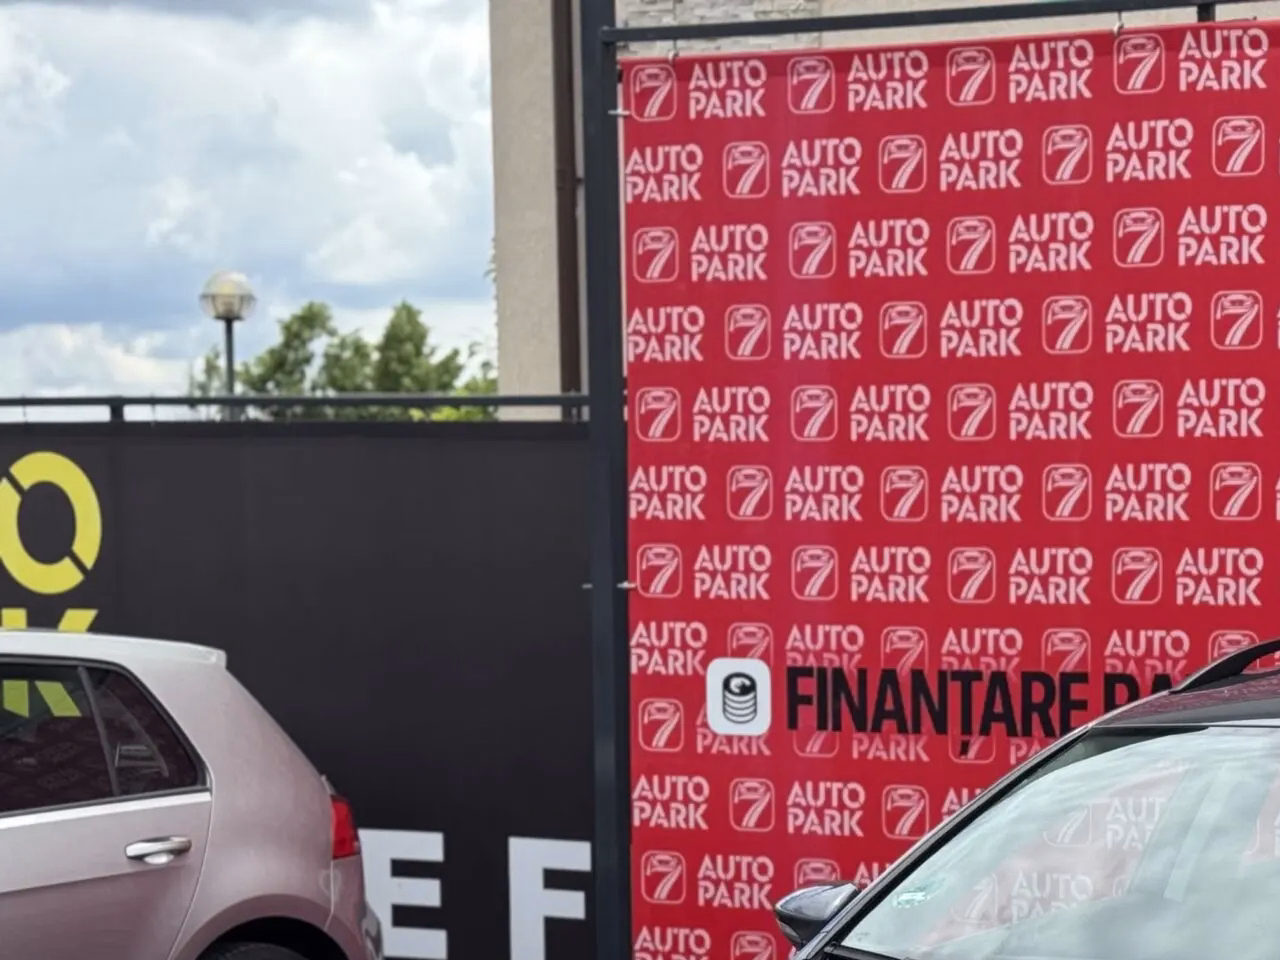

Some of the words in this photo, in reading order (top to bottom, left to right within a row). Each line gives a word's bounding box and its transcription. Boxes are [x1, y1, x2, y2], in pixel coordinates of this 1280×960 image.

[1009, 39, 1093, 72] AUTO
[1179, 28, 1268, 59] AUTO
[689, 60, 766, 89] AUTO
[848, 51, 928, 81] AUTO
[1180, 59, 1266, 91] PARK
[848, 79, 927, 111] PARK
[1009, 69, 1092, 103] PARK
[690, 88, 765, 119] PARK
[940, 129, 1023, 161] AUTO
[1106, 118, 1193, 151] AUTO
[625, 144, 702, 174] AUTO
[781, 137, 861, 168] AUTO
[1107, 149, 1191, 182] PARK
[626, 174, 702, 203] PARK
[782, 166, 860, 197] PARK
[940, 159, 1020, 191] PARK
[848, 218, 929, 248] AUTO
[1009, 211, 1094, 242] AUTO
[1178, 204, 1267, 235] AUTO
[691, 224, 768, 252] AUTO
[1179, 235, 1264, 266] PARK
[692, 253, 767, 281] PARK
[849, 248, 928, 277] PARK
[1010, 241, 1091, 273] PARK
[627, 306, 704, 336] AUTO
[783, 302, 862, 331] AUTO
[940, 298, 1023, 328] AUTO
[1106, 292, 1192, 322] AUTO
[628, 334, 704, 362] PARK
[784, 331, 860, 360] PARK
[941, 328, 1021, 357] PARK
[1106, 322, 1190, 352] PARK
[693, 386, 770, 413] AUTO
[850, 384, 930, 412] AUTO
[1009, 381, 1093, 410] AUTO
[1177, 378, 1265, 407] AUTO
[694, 414, 768, 441] PARK
[851, 413, 928, 441] PARK
[1010, 411, 1091, 440] PARK
[1178, 408, 1263, 437] PARK
[629, 465, 706, 492] AUTO
[785, 466, 864, 493] AUTO
[941, 465, 1023, 493] AUTO
[1105, 463, 1191, 491] AUTO
[630, 493, 704, 520] PARK
[786, 494, 861, 520] PARK
[942, 494, 1021, 522] PARK
[1106, 493, 1189, 520] PARK
[694, 545, 771, 572] AUTO
[851, 547, 930, 573] AUTO
[1009, 547, 1092, 575] AUTO
[1176, 548, 1263, 576] AUTO
[695, 572, 769, 599] PARK
[851, 574, 928, 602] PARK
[1010, 576, 1090, 604] PARK
[1177, 577, 1261, 605] PARK
[630, 622, 707, 648] AUTO
[786, 624, 864, 651] AUTO
[942, 628, 1022, 654] AUTO
[1105, 630, 1189, 657] AUTO
[630, 649, 705, 676] PARK
[632, 775, 709, 802] AUTO
[787, 781, 865, 808] AUTO
[634, 801, 708, 829] PARK
[788, 807, 863, 836] PARK
[698, 855, 773, 882] AUTO
[697, 883, 774, 909] PARK
[635, 927, 710, 954] AUTO
